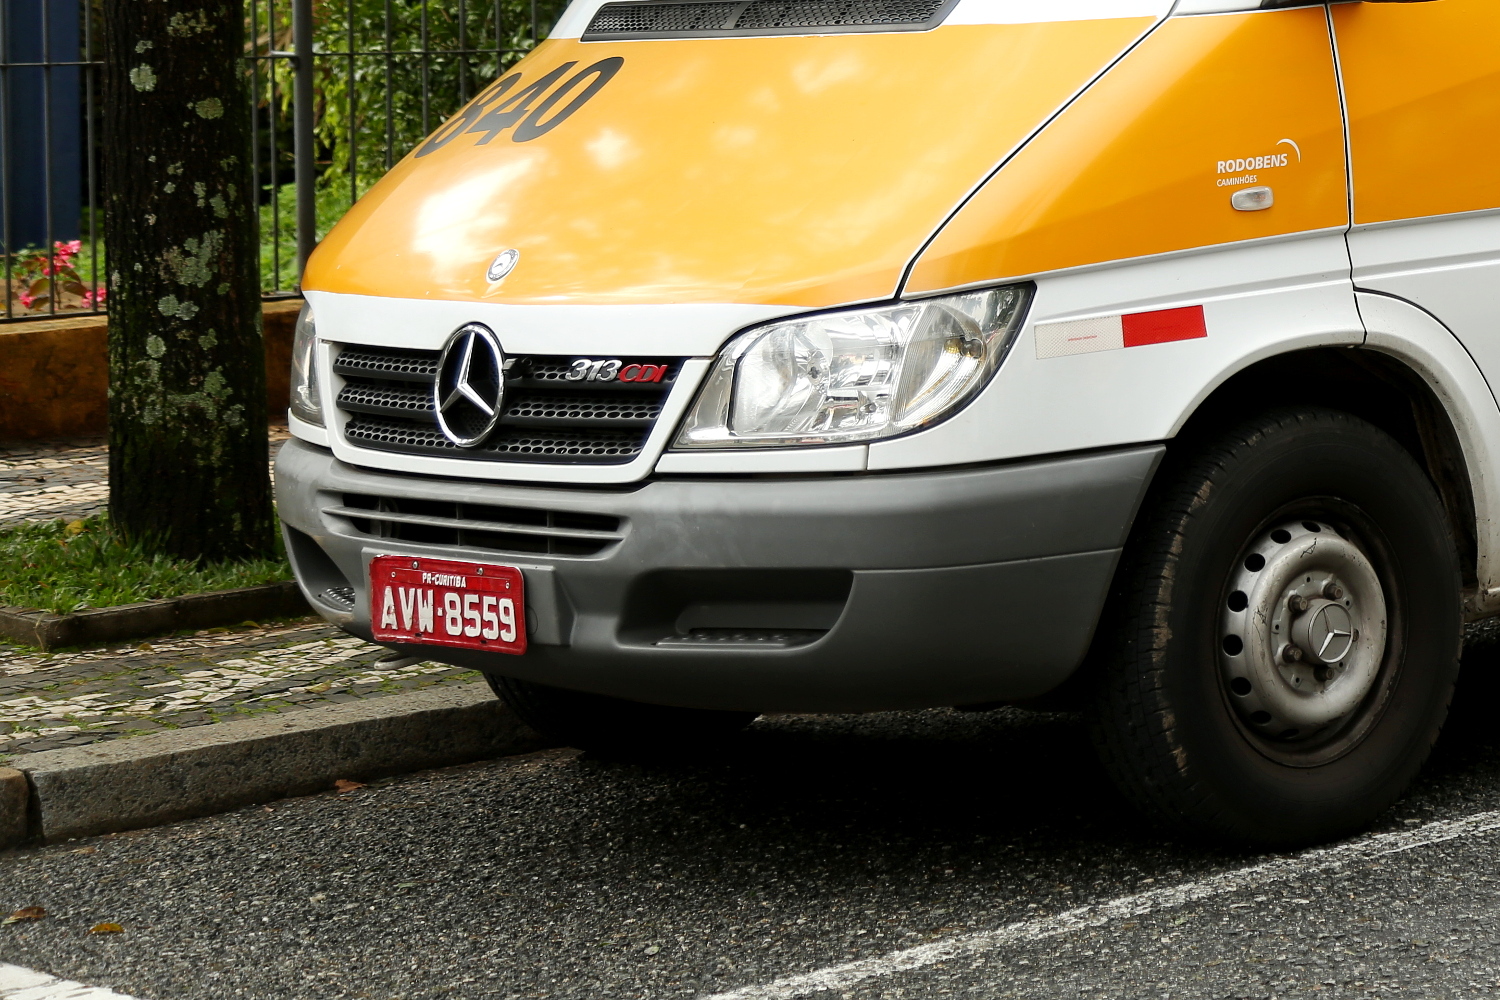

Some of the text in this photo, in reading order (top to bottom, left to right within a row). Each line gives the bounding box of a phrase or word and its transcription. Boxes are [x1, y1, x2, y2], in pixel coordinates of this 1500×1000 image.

[414, 56, 625, 158] 840
[1217, 153, 1288, 174] RODOBENS
[1216, 174, 1257, 187] CAMINHÕES
[565, 358, 669, 383] 313 CDI
[422, 572, 467, 588] PR-CURITIBA
